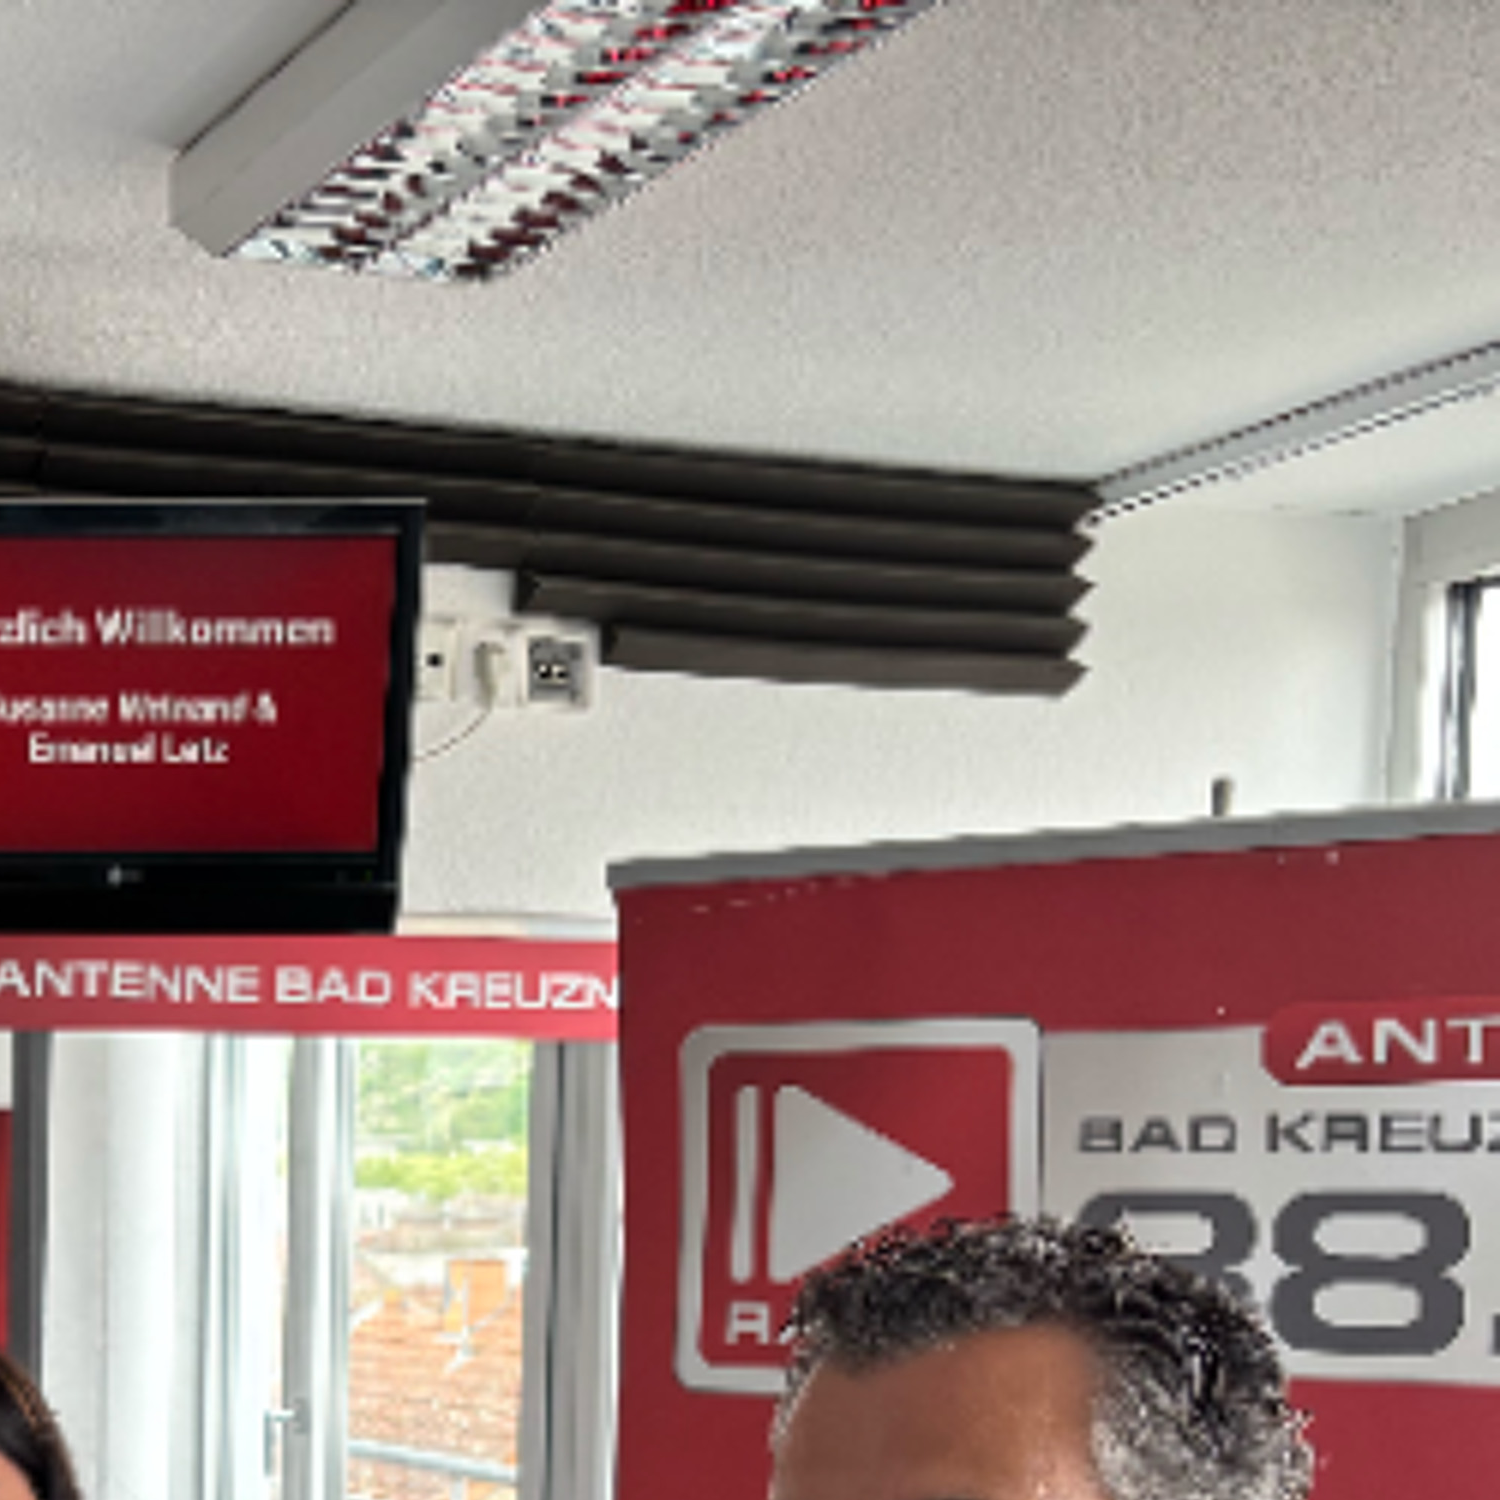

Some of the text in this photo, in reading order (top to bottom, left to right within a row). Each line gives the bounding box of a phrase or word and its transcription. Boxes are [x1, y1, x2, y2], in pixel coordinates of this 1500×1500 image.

[95, 609, 336, 646] Willkommen
[28, 732, 155, 764] Emanuel
[274, 964, 394, 1003] BAD
[1295, 1018, 1500, 1070] ANT
[1078, 1114, 1238, 1153] BAD
